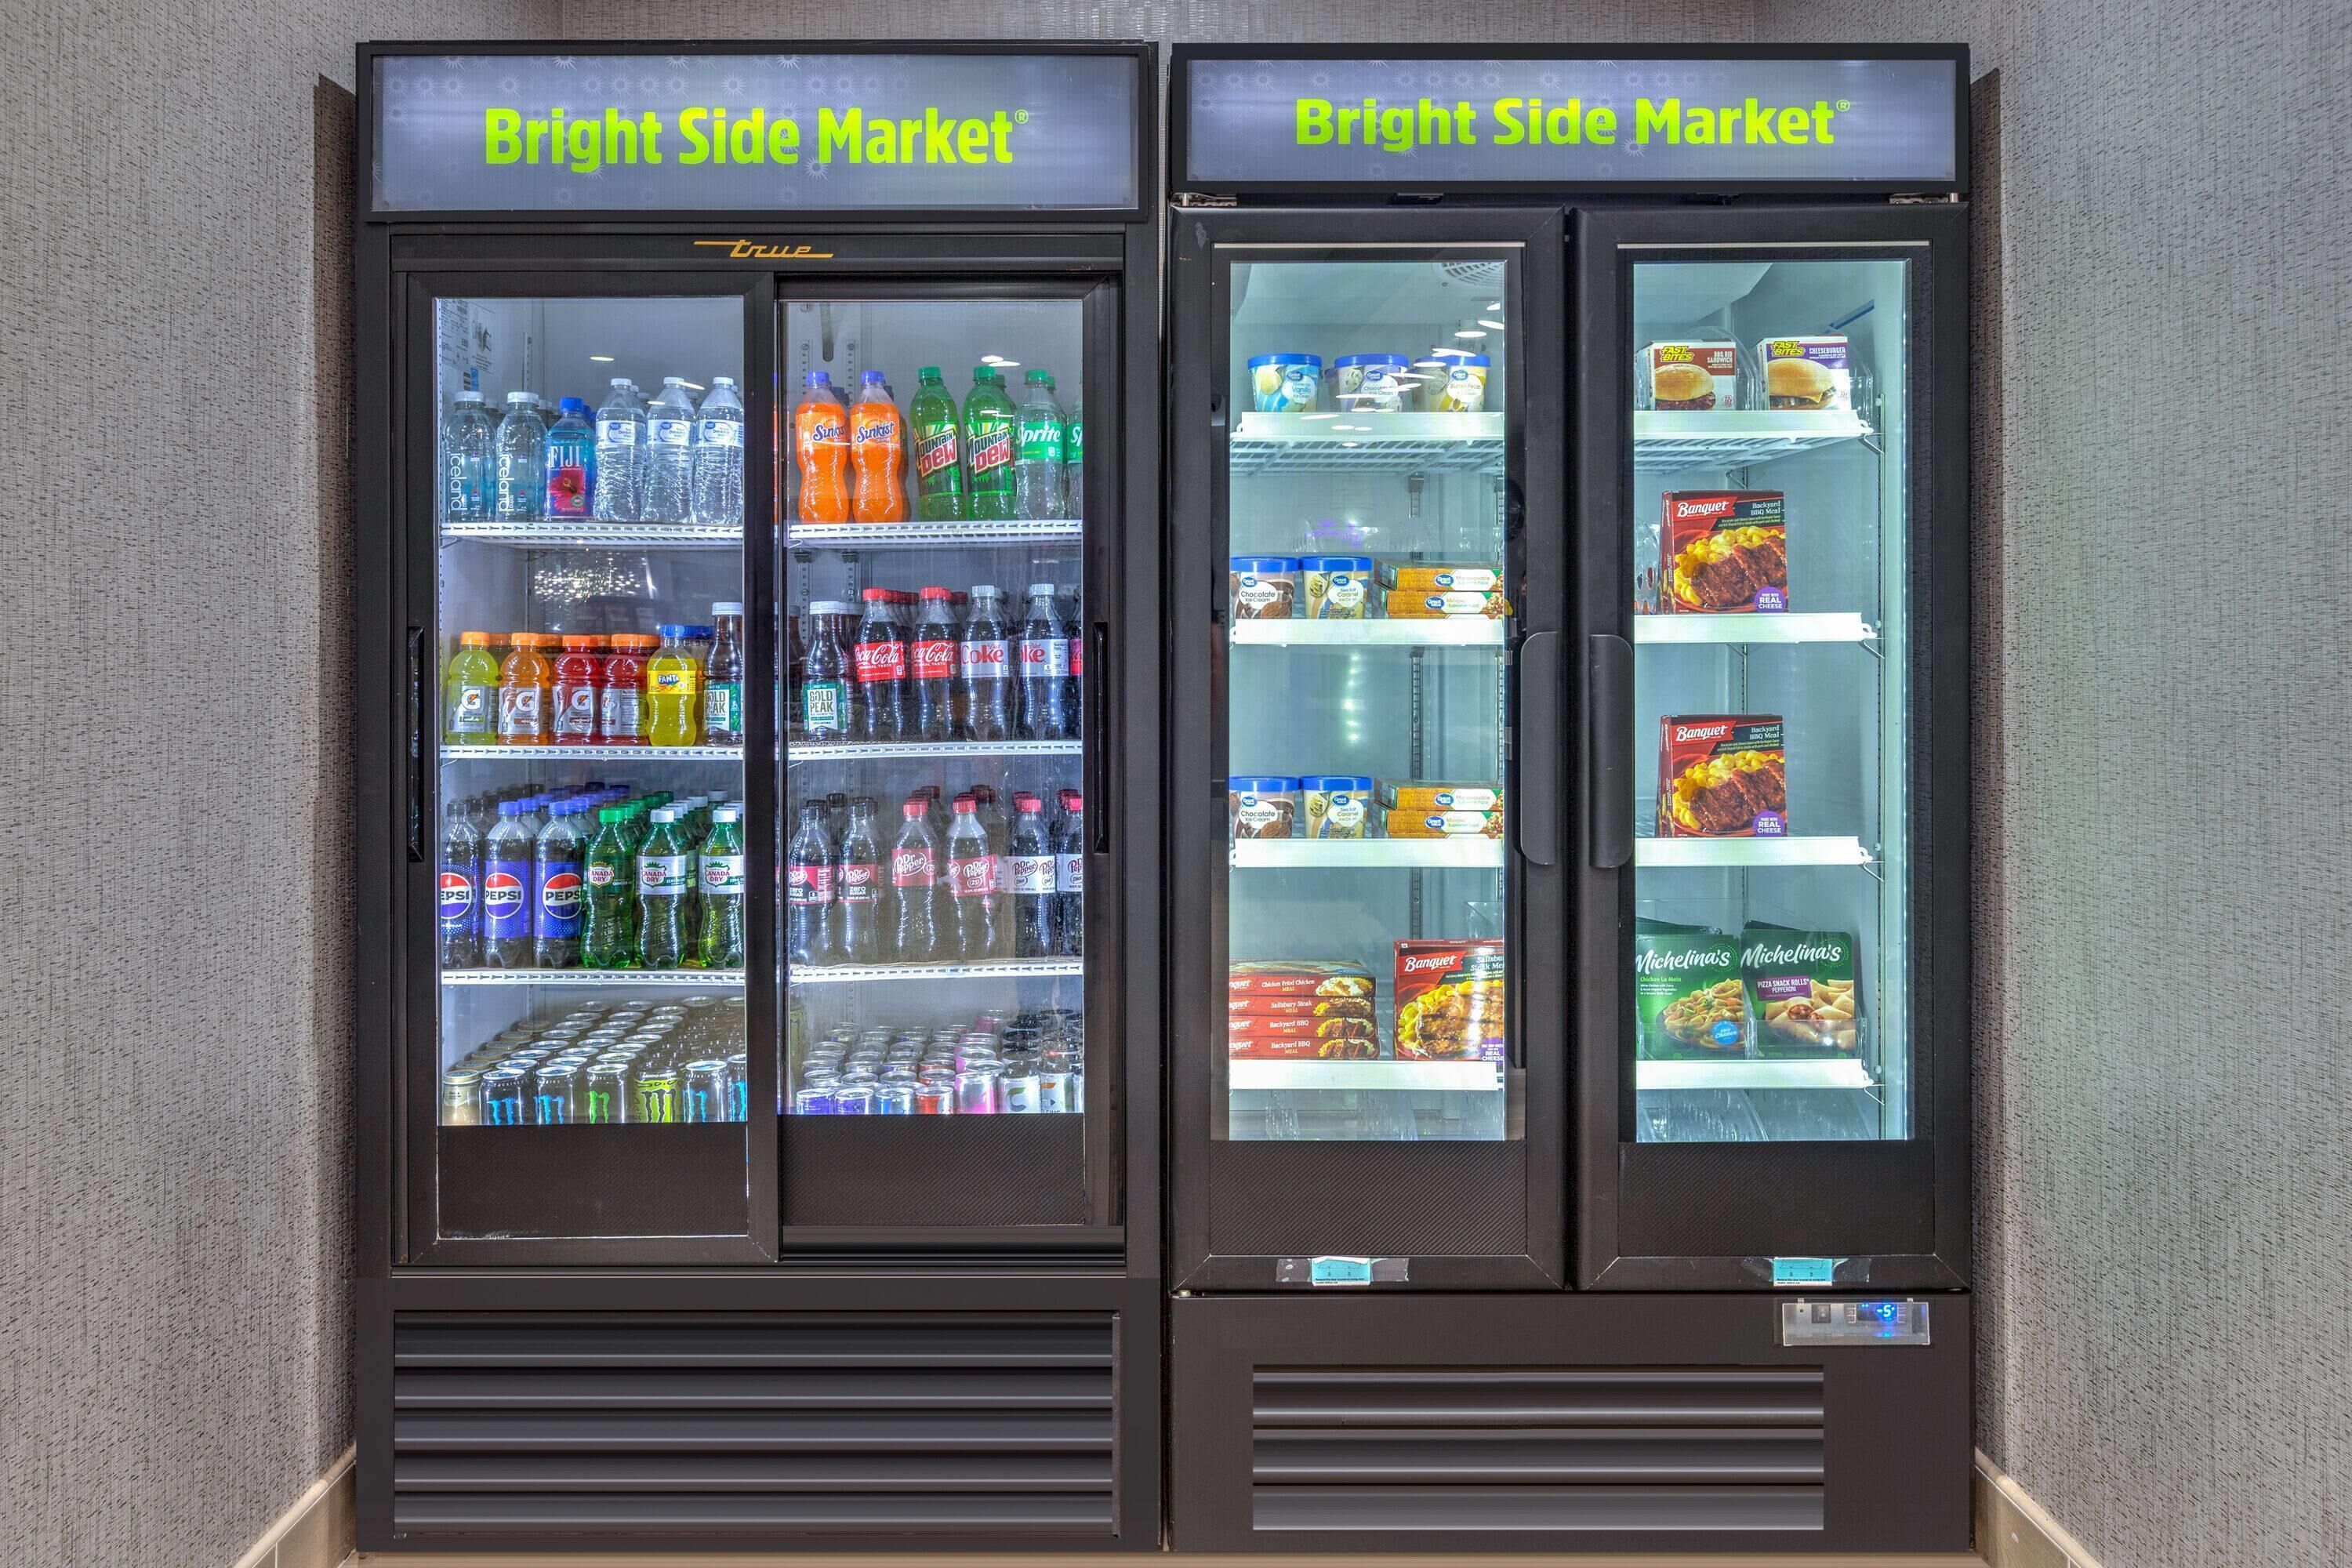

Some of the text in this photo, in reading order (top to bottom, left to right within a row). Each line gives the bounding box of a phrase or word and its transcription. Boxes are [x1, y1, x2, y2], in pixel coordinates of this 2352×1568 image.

[1296, 98, 1476, 152] Bright
[1493, 98, 1617, 145] Side
[486, 108, 662, 173] Bright
[679, 107, 800, 164] Side
[1663, 353, 1694, 361] BITES
[813, 424, 845, 441] Sunkis
[857, 422, 895, 443] Sunkist
[550, 445, 581, 468] FIJI
[1677, 500, 1730, 517] Banquet
[1752, 500, 1780, 510] Backyard
[961, 644, 1004, 664] Coke
[658, 673, 680, 684] FANTA
[461, 689, 481, 710] G
[516, 691, 535, 712] G
[572, 690, 591, 710] G
[809, 690, 833, 701] GOLD
[810, 702, 833, 713] PEAK
[1675, 725, 1729, 742] Banquet
[1751, 725, 1780, 734] Backyard
[896, 857, 924, 873] Pepper
[902, 854, 916, 863] Dr
[1014, 862, 1036, 876] Pepper
[546, 891, 581, 901] PEPS
[1404, 955, 1458, 972] Banquet
[1635, 949, 1731, 975] Michelina's
[1740, 943, 1842, 968] Michelina's
